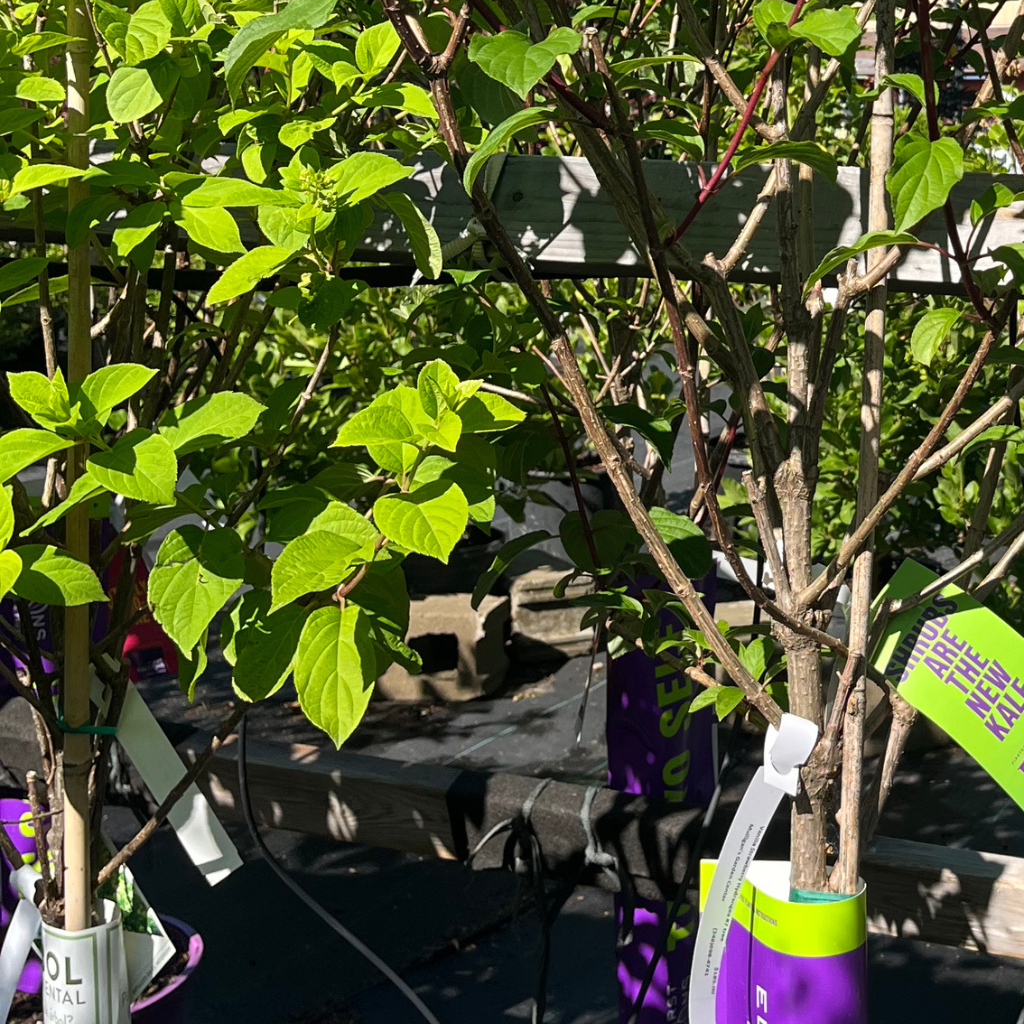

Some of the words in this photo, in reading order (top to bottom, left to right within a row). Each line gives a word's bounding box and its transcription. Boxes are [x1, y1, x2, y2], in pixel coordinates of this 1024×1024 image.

[885, 594, 958, 684] SHRUBS
[923, 629, 968, 680] ARE
[944, 646, 990, 694] THE
[964, 659, 1012, 720] NEW
[734, 823, 754, 855] Mulligan's
[750, 825, 765, 848] Vanilla
[727, 856, 741, 880] Garden
[738, 848, 755, 882] Strawberry
[719, 880, 732, 902] Center
